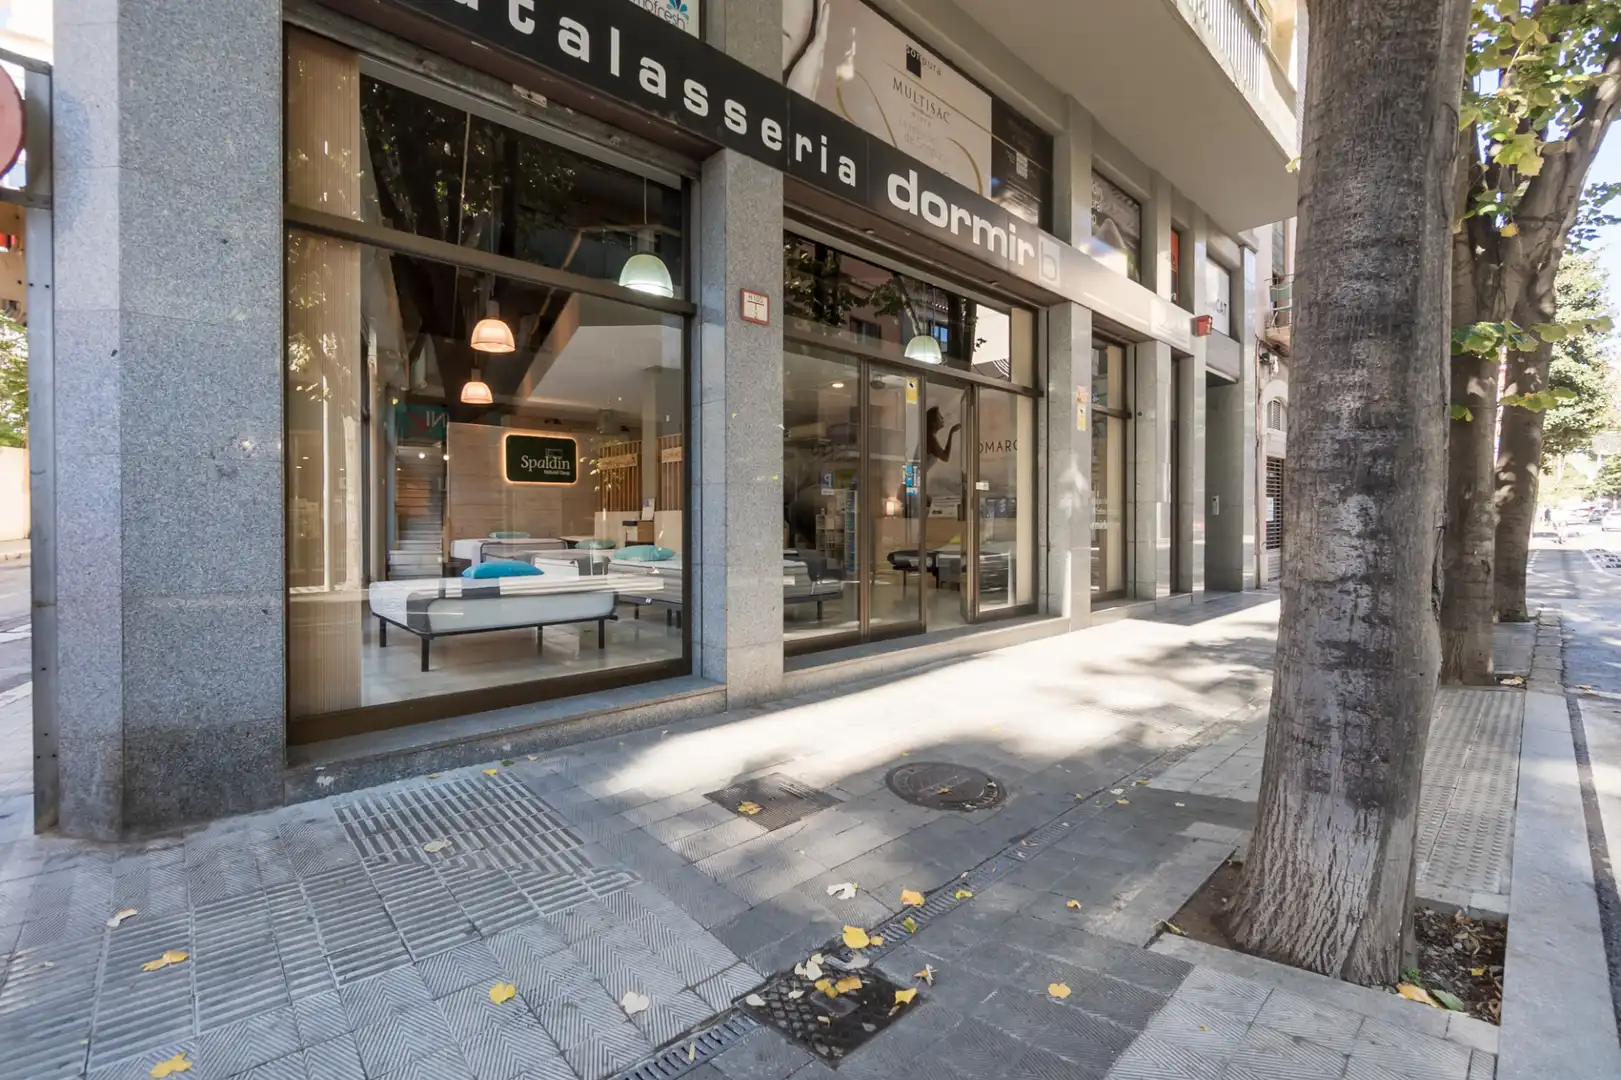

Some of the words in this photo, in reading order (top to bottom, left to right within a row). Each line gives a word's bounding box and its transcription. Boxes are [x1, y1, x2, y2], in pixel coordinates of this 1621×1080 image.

[629, 0, 686, 30] ofresh
[453, 0, 857, 188] talasseria
[893, 77, 950, 124] MULTISAC
[887, 169, 1035, 265] dormir
[521, 454, 571, 472] Spaldin
